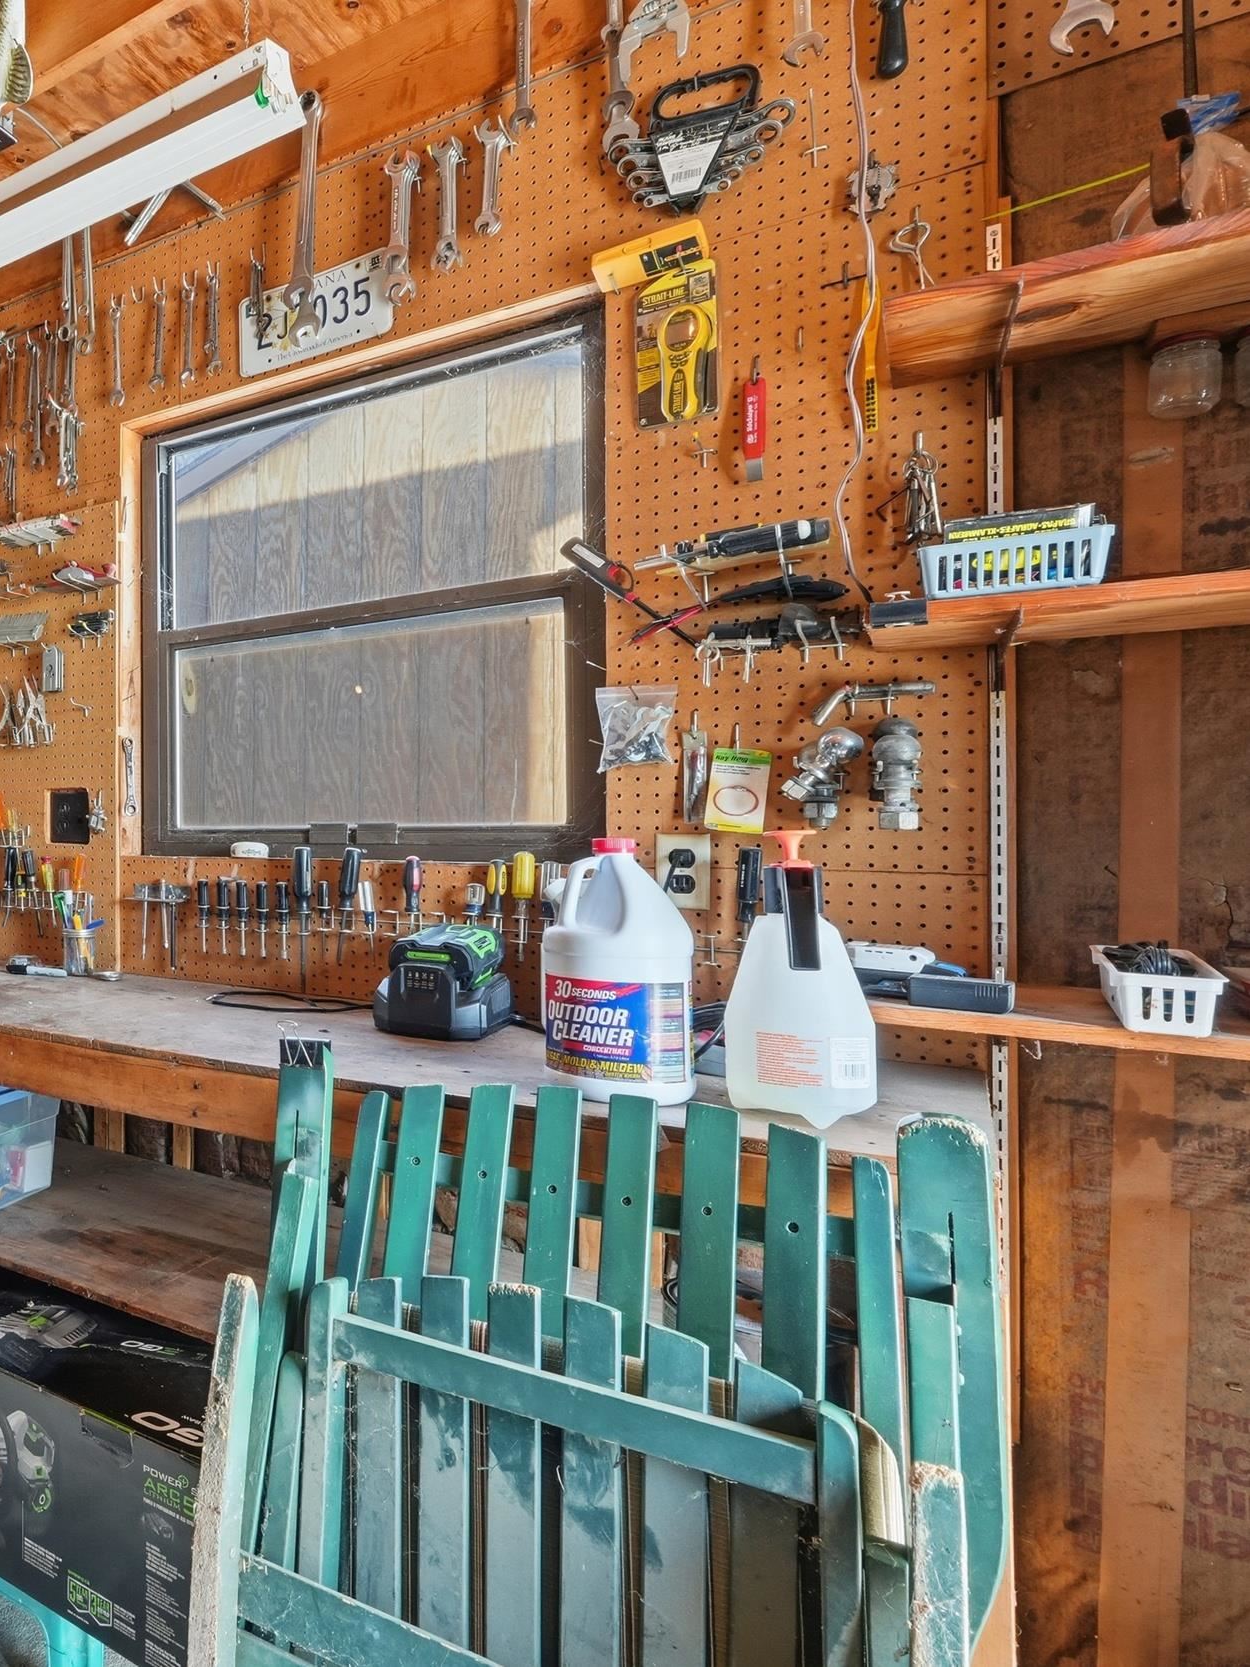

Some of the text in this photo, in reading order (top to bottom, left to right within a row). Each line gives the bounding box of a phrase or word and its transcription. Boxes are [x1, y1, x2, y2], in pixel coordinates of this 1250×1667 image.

[554, 979, 616, 1000] 30 SECONDS
[548, 999, 628, 1026] OUTDOOR
[553, 1020, 635, 1047] CLEANER
[582, 1044, 631, 1056] CONCENTRATE
[600, 1060, 644, 1073] MILDEW
[120, 1340, 176, 1356] EGO
[131, 1411, 205, 1448] GO
[142, 1464, 183, 1489] POWER
[143, 1488, 181, 1512] LITHIUM
[144, 1479, 181, 1504] ARC
